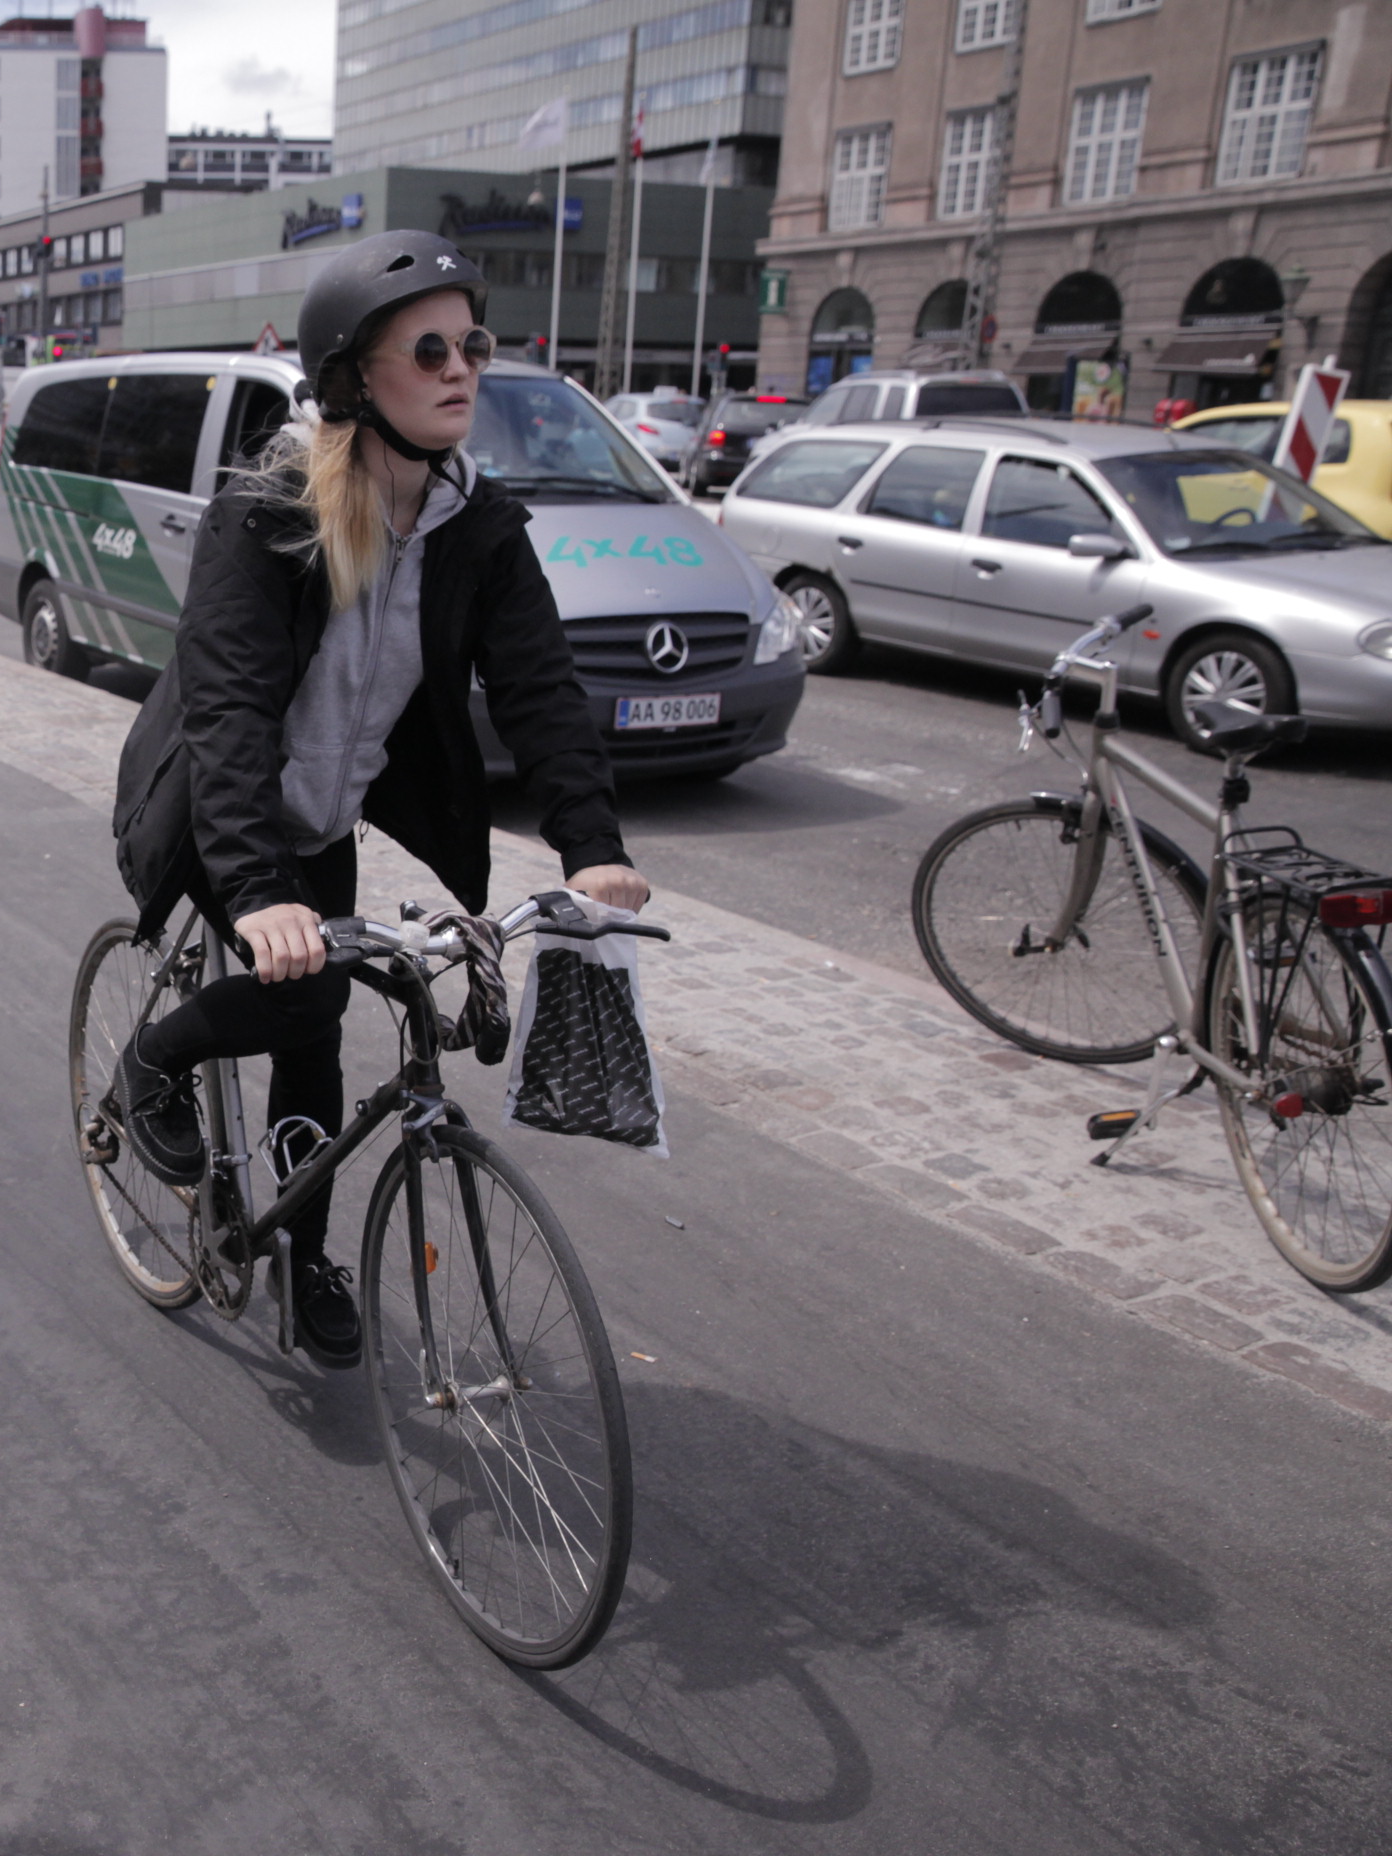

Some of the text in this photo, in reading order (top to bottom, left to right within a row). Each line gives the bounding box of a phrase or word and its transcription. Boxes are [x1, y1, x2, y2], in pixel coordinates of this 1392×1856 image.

[546, 534, 705, 568] 4x48
[630, 698, 717, 722] AA 98 006
[1109, 806, 1167, 957] CENTURION
